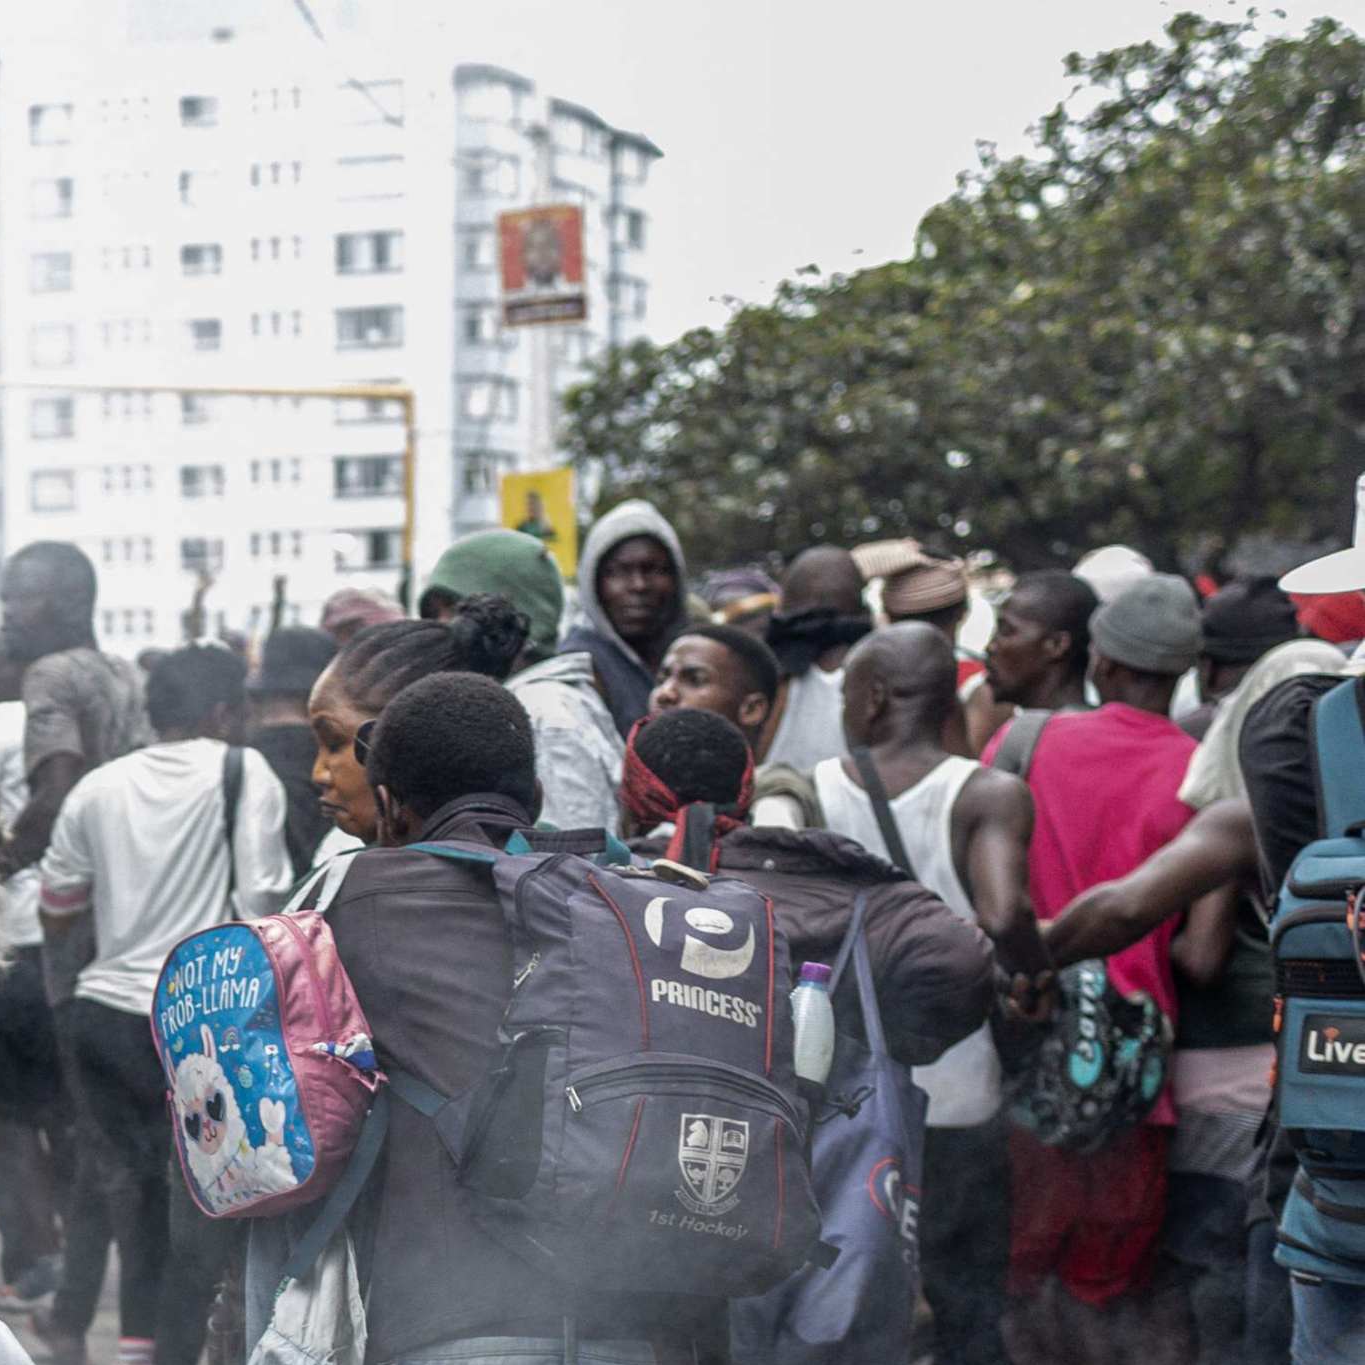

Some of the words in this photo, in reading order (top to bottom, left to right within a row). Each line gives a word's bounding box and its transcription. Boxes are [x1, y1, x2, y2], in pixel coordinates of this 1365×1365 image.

[175, 955, 207, 997] NOT
[212, 946, 243, 980] MY
[161, 978, 260, 1040] PROB-LLAMA
[651, 979, 757, 1028] PRINCESS
[650, 1210, 676, 1226] 1st
[679, 1215, 748, 1240] Hockey
